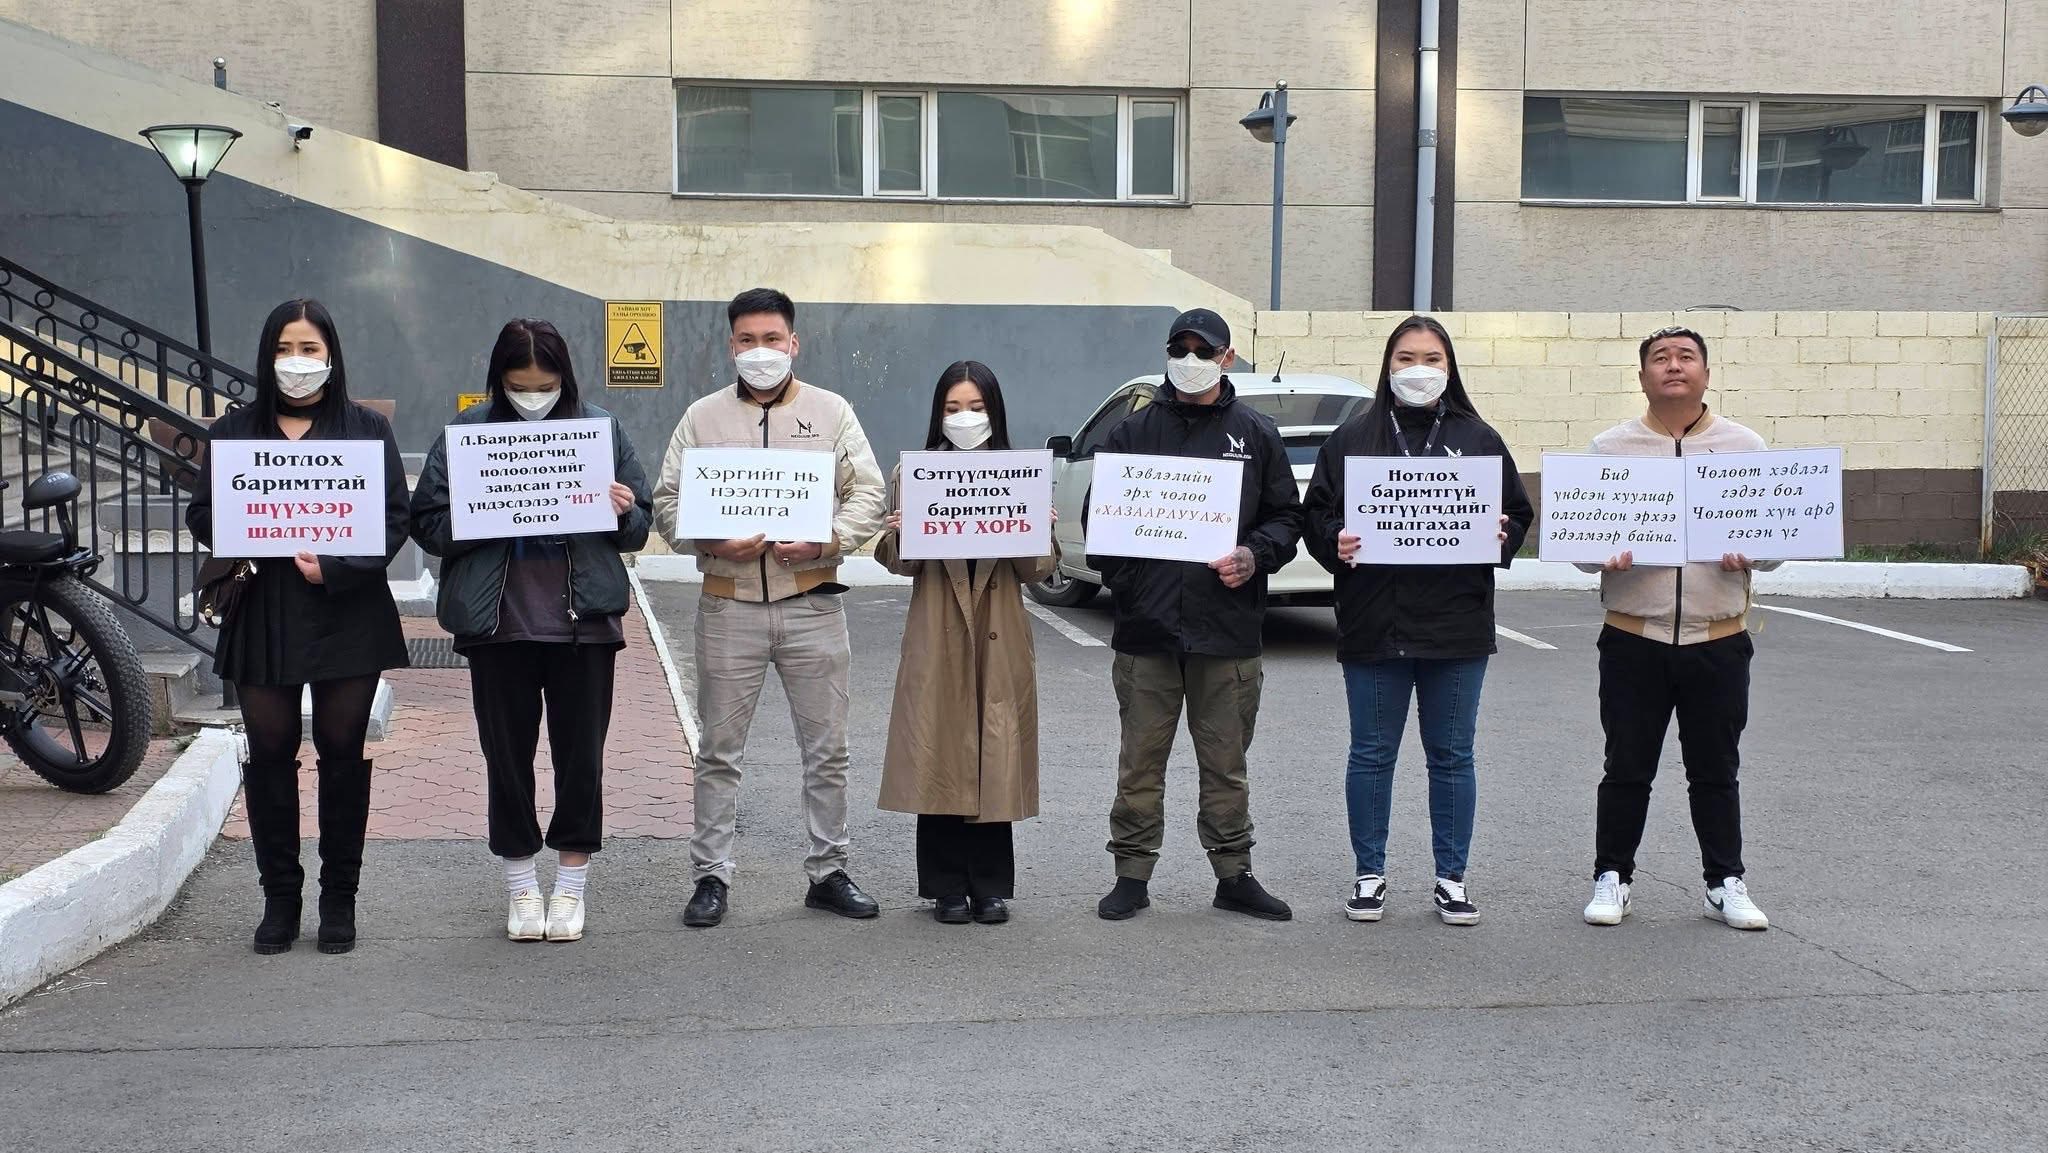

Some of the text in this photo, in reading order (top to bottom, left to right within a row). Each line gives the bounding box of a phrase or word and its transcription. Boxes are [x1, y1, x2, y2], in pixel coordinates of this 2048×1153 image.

[460, 430, 600, 446] Л.Баяржаргалыг
[254, 452, 344, 467] Нотлох
[696, 467, 819, 483] Хэргийг нь
[913, 466, 1043, 483] Сэтгүүлчдийг
[1121, 466, 1213, 484] Хэвлэлийн
[1388, 470, 1459, 482] Нотлох
[1600, 468, 1630, 481] Бид
[1697, 462, 1829, 479] Чөлөөт хэвлэл
[231, 473, 366, 495] баримттай
[485, 479, 582, 494] завдсан гэх
[945, 486, 1011, 498] нотлох
[1721, 482, 1803, 499] гэдэг бол
[711, 486, 809, 500] нээлттэй
[1123, 487, 1152, 501] эрх
[1371, 484, 1476, 501] баримтгүй
[1553, 488, 1674, 505] үндсэн хуулиар
[246, 502, 353, 520] шүүхээр
[468, 497, 559, 514] үндэслэлээ
[721, 505, 789, 517] шалга
[927, 502, 1027, 519] баримтгүй
[1357, 502, 1491, 518] сэтгүүлчдийг
[1693, 502, 1835, 520] Чөлөөт хүн ард
[512, 512, 560, 524] болго
[1551, 509, 1677, 525] олгогдсон эрхээ
[923, 519, 1032, 535] БҮҮ ХОРЬ
[1134, 524, 1188, 540] байна.
[1377, 520, 1471, 531] шалгахаа
[1728, 527, 1799, 540] гэсэн үг
[247, 526, 353, 542] шалгуул
[1393, 537, 1460, 547] зогсоо
[1550, 528, 1677, 545] эдэлмээр байна.
